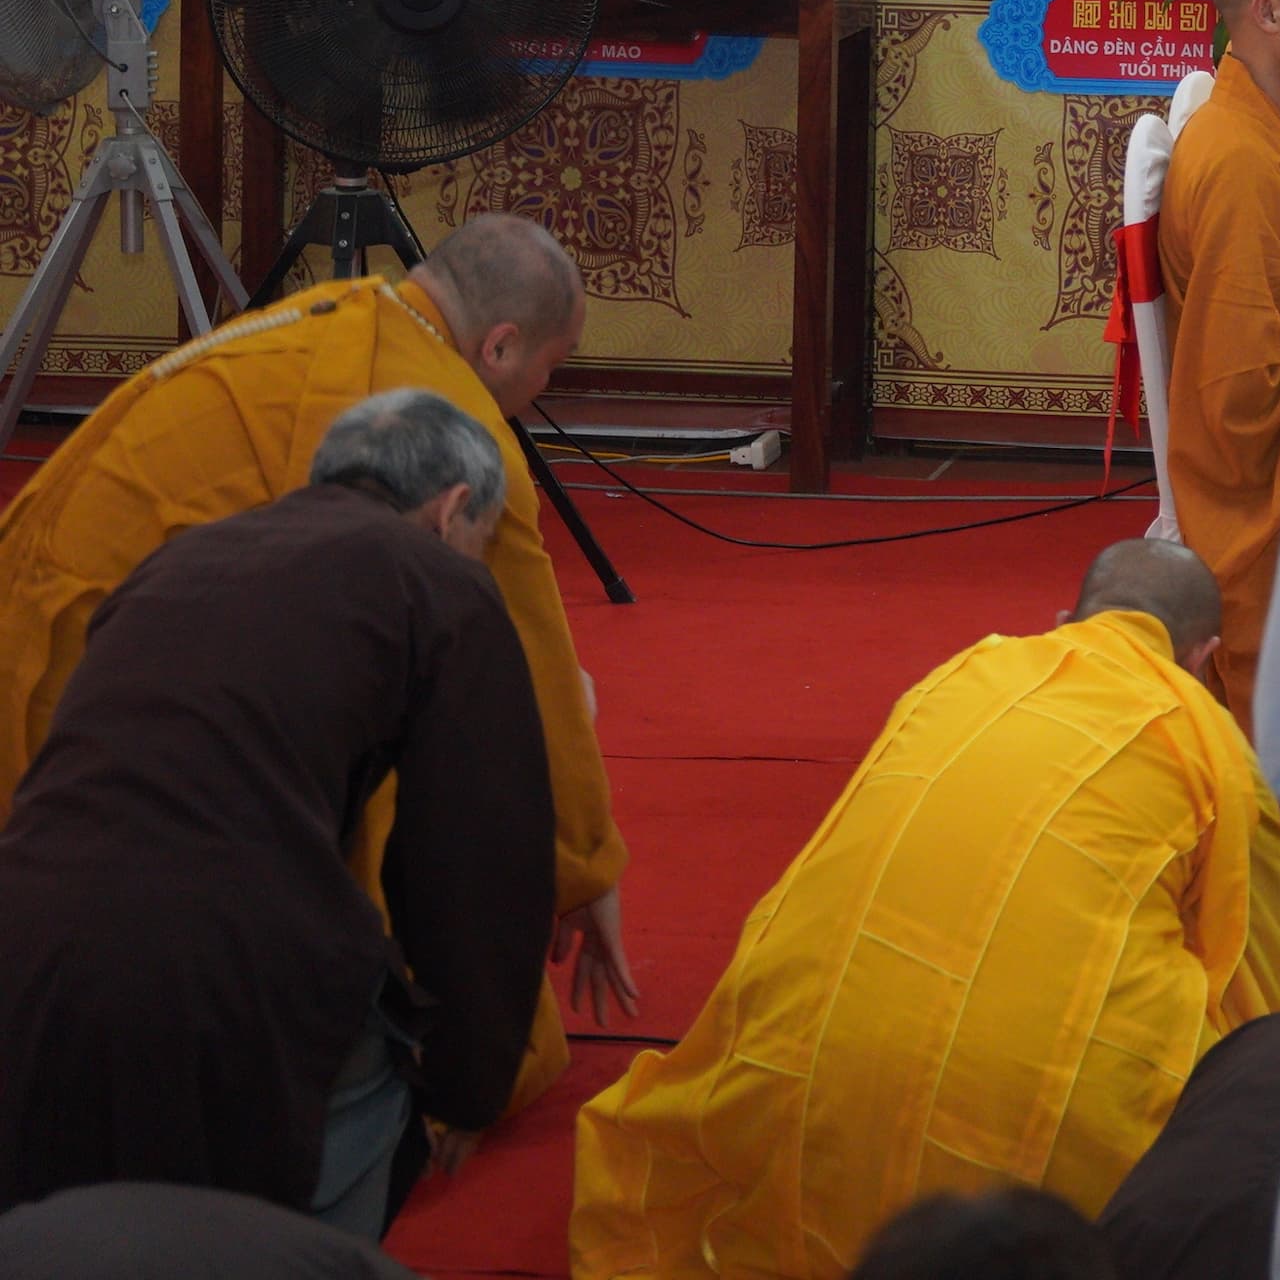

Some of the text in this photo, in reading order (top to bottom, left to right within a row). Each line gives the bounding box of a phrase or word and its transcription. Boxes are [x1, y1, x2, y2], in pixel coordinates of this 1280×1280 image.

[1050, 36, 1204, 58] DÂNG ĐÈN CẦU AN
[1119, 57, 1156, 77] TUỔI
